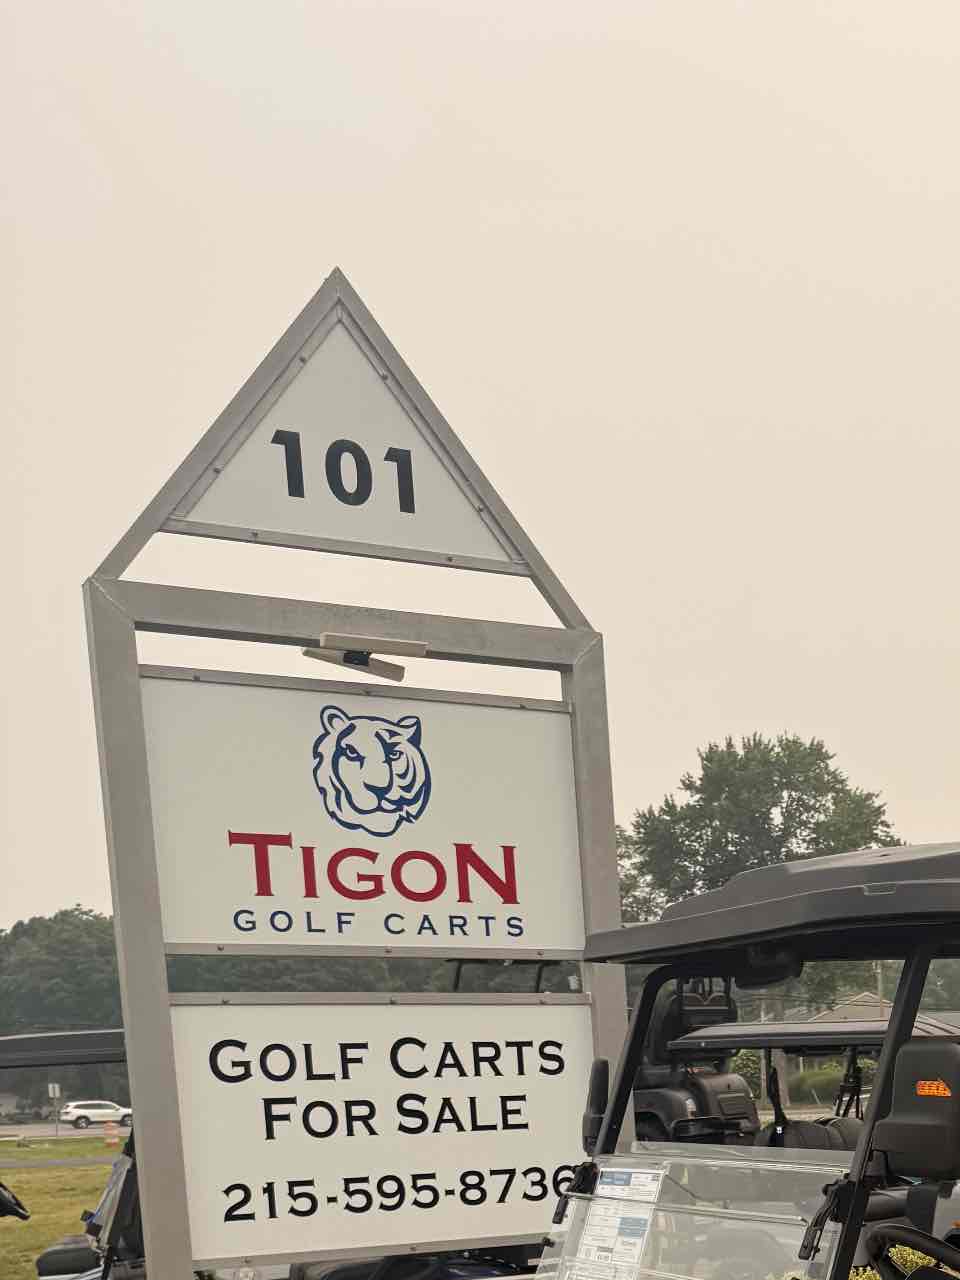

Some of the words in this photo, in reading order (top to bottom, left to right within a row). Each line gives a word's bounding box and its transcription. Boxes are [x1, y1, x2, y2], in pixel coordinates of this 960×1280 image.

[270, 428, 417, 515] 101
[227, 829, 521, 905] TIGON
[233, 909, 357, 934] GOLF
[383, 912, 525, 938] CARTS
[208, 1037, 370, 1084] GOLF
[389, 1036, 566, 1080] CARTS
[261, 1095, 379, 1141] FOR
[396, 1093, 530, 1136] SALE
[221, 1163, 577, 1223] 215-595-8736
